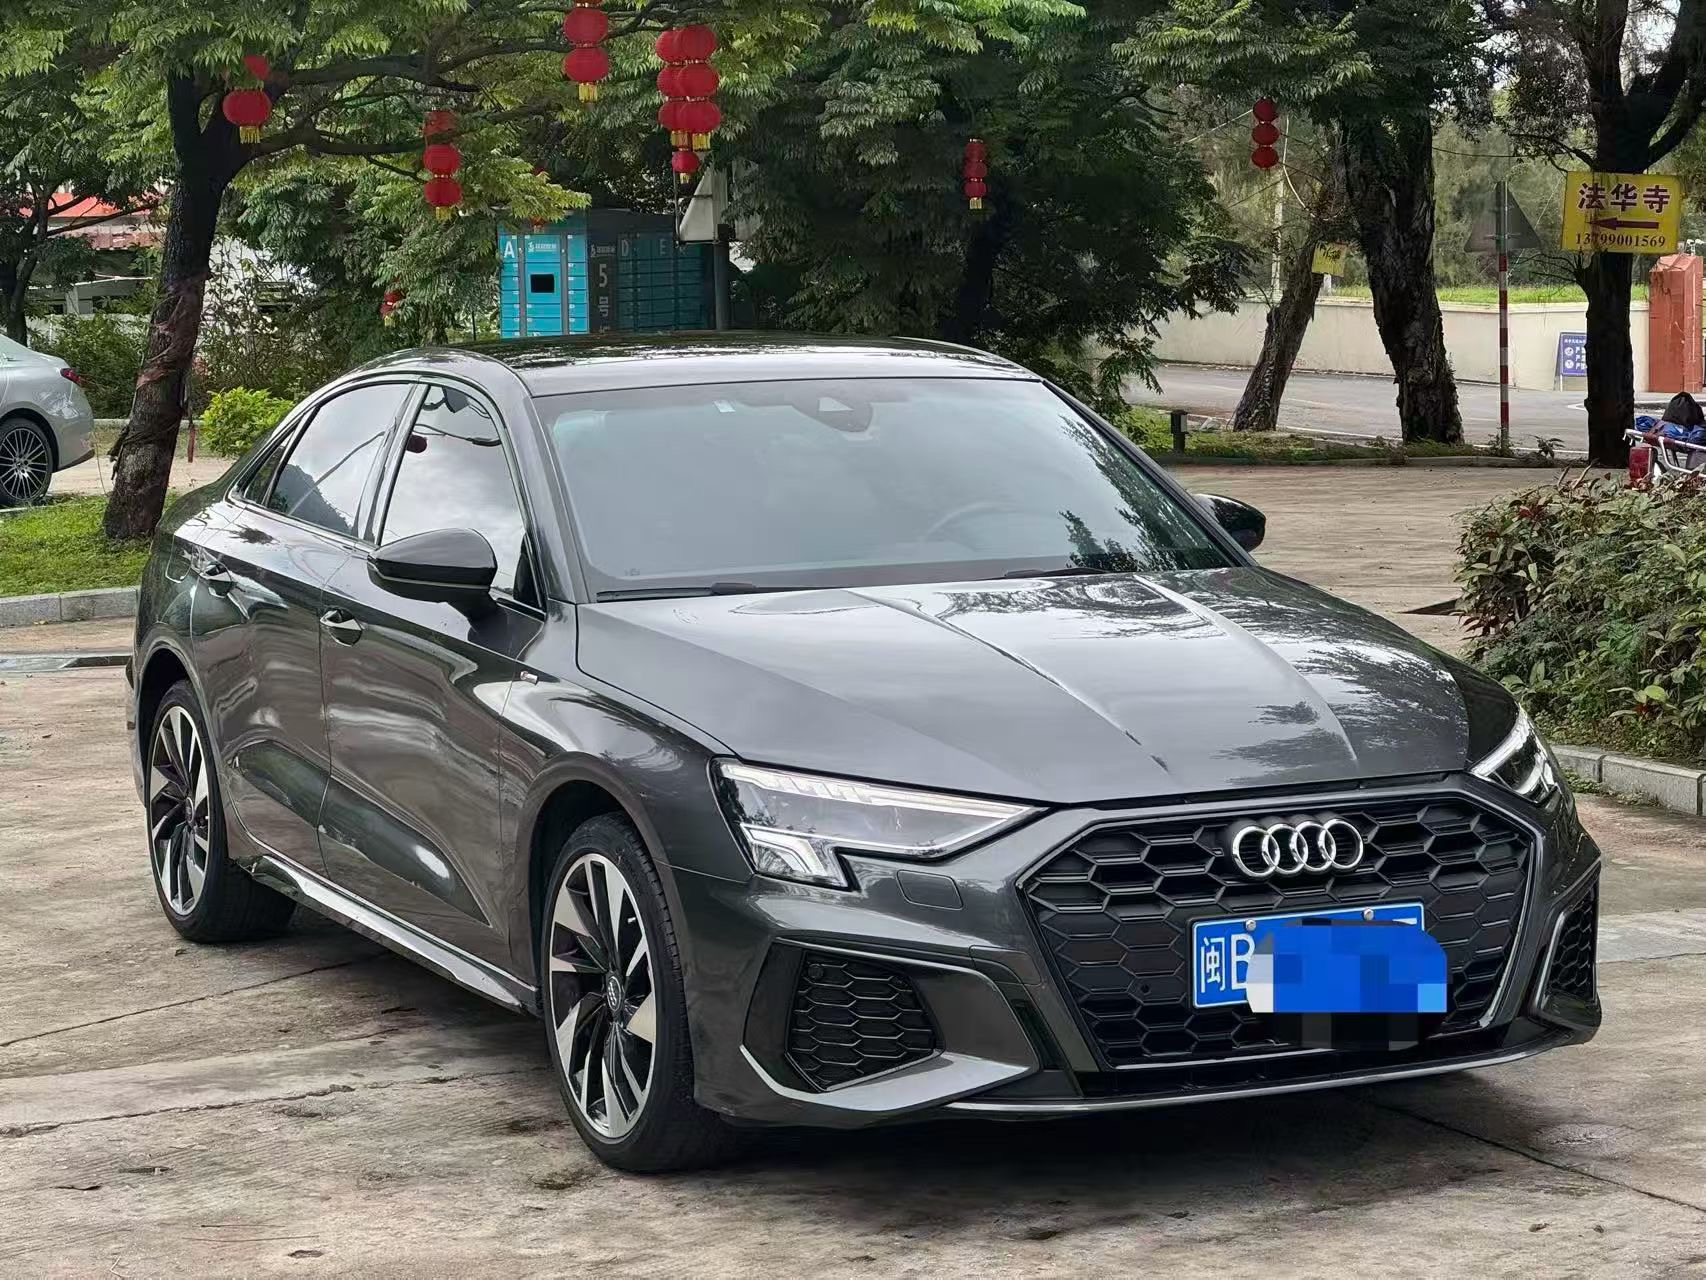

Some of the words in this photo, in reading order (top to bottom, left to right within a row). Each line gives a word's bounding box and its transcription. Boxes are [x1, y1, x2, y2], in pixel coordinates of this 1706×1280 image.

[1578, 182, 1671, 213] 法华寺
[503, 241, 515, 259] A
